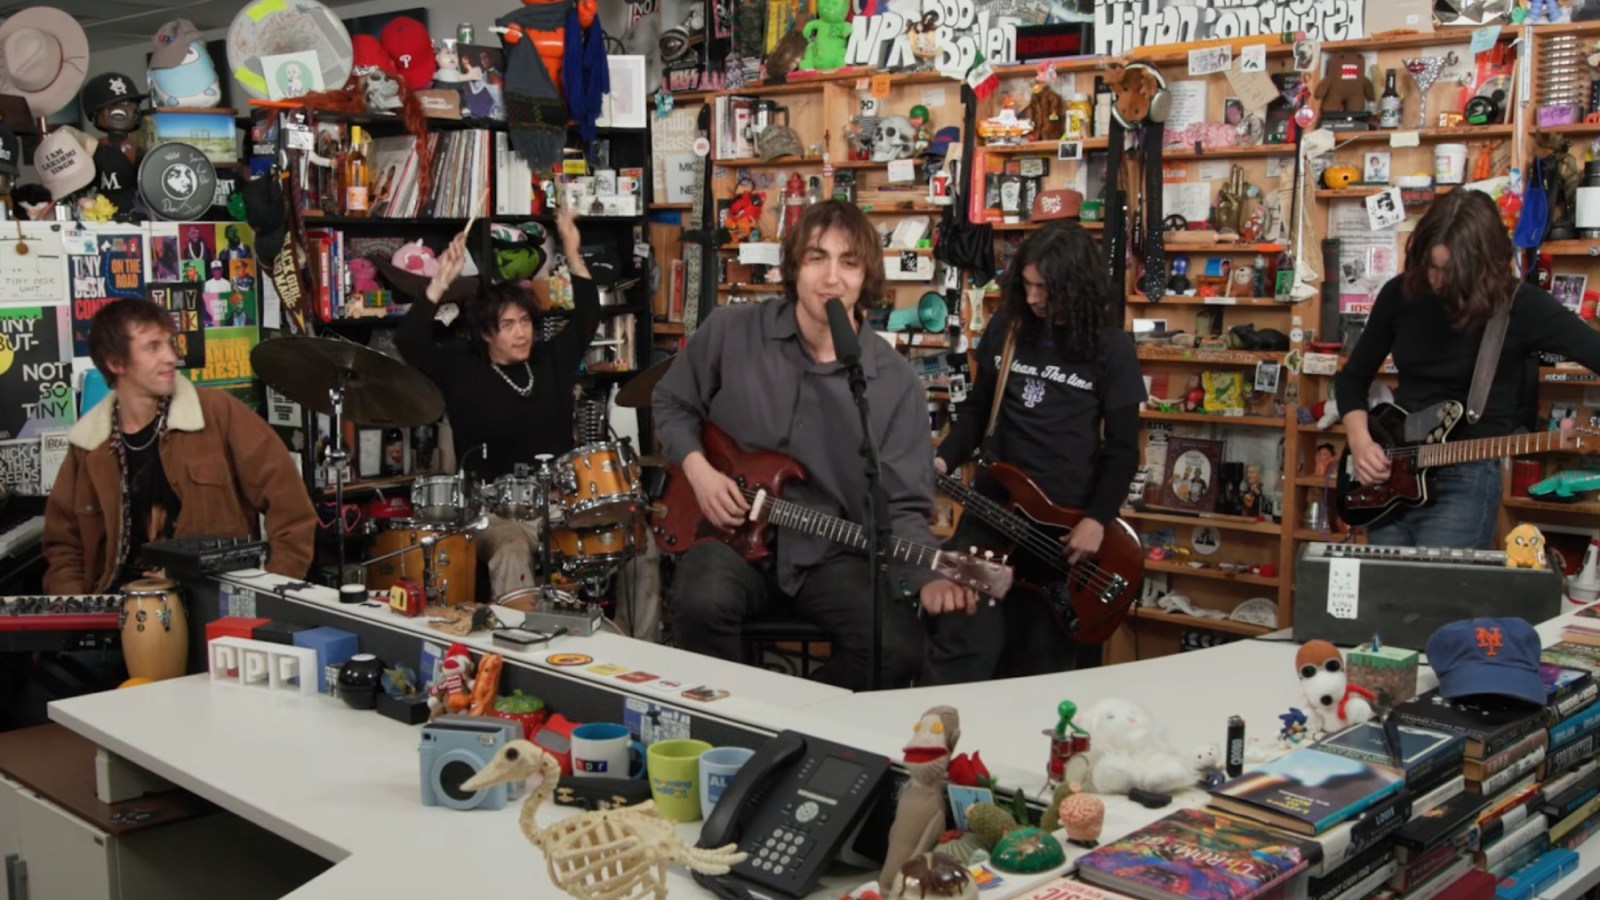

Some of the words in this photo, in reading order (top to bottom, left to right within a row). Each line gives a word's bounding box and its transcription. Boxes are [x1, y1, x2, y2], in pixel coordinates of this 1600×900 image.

[1095, 0, 1197, 56] Hilton
[670, 70, 699, 91] KISS
[253, 143, 275, 155] music
[100, 171, 122, 190] M
[111, 259, 124, 273] ON
[125, 259, 141, 273] THE
[0, 315, 38, 334] INY
[22, 361, 67, 382] NOT
[1041, 364, 1067, 383] The
[39, 381, 68, 399] SO
[21, 401, 69, 421] TINY
[1475, 627, 1503, 657] NY
[215, 644, 300, 683] npr
[576, 759, 605, 771] npr
